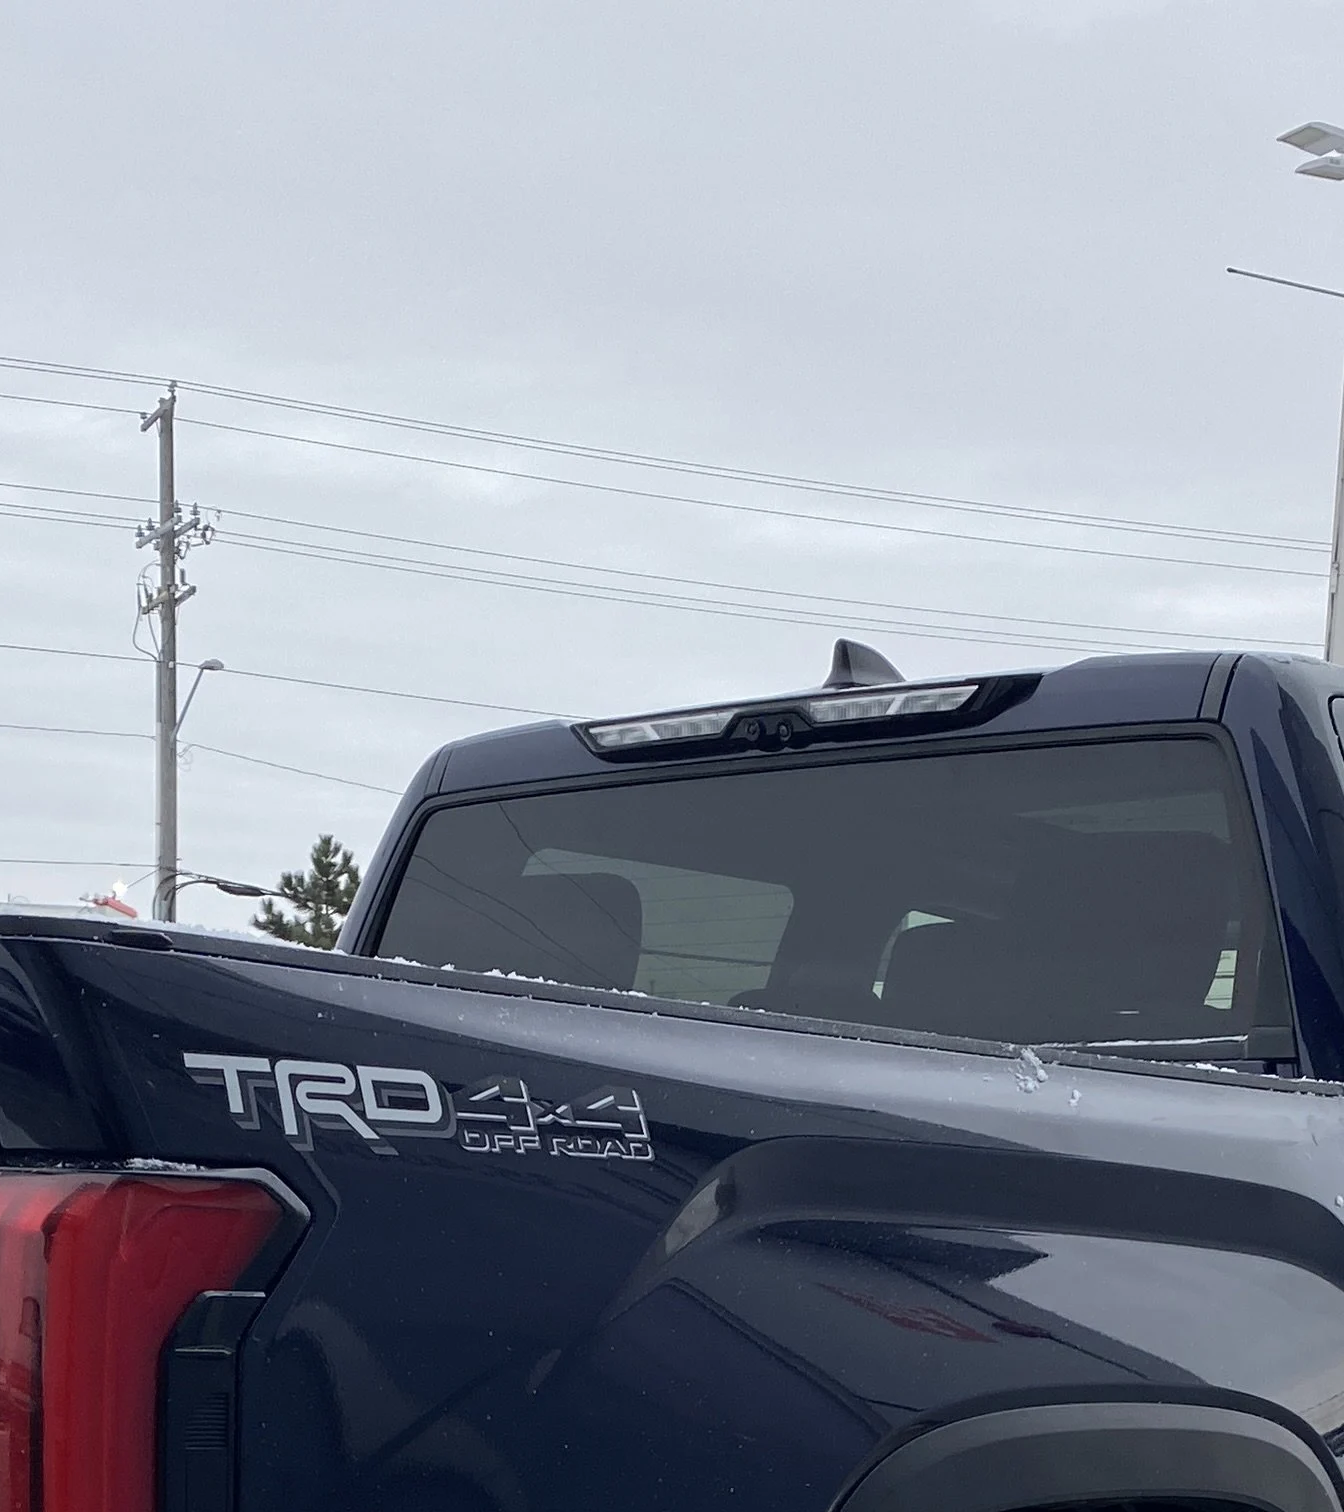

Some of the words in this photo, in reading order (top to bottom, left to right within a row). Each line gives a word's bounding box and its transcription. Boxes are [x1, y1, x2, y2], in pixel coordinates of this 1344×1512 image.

[182, 1052, 448, 1145] TRD
[458, 1129, 542, 1156] OFF
[549, 1137, 656, 1162] ROAD
